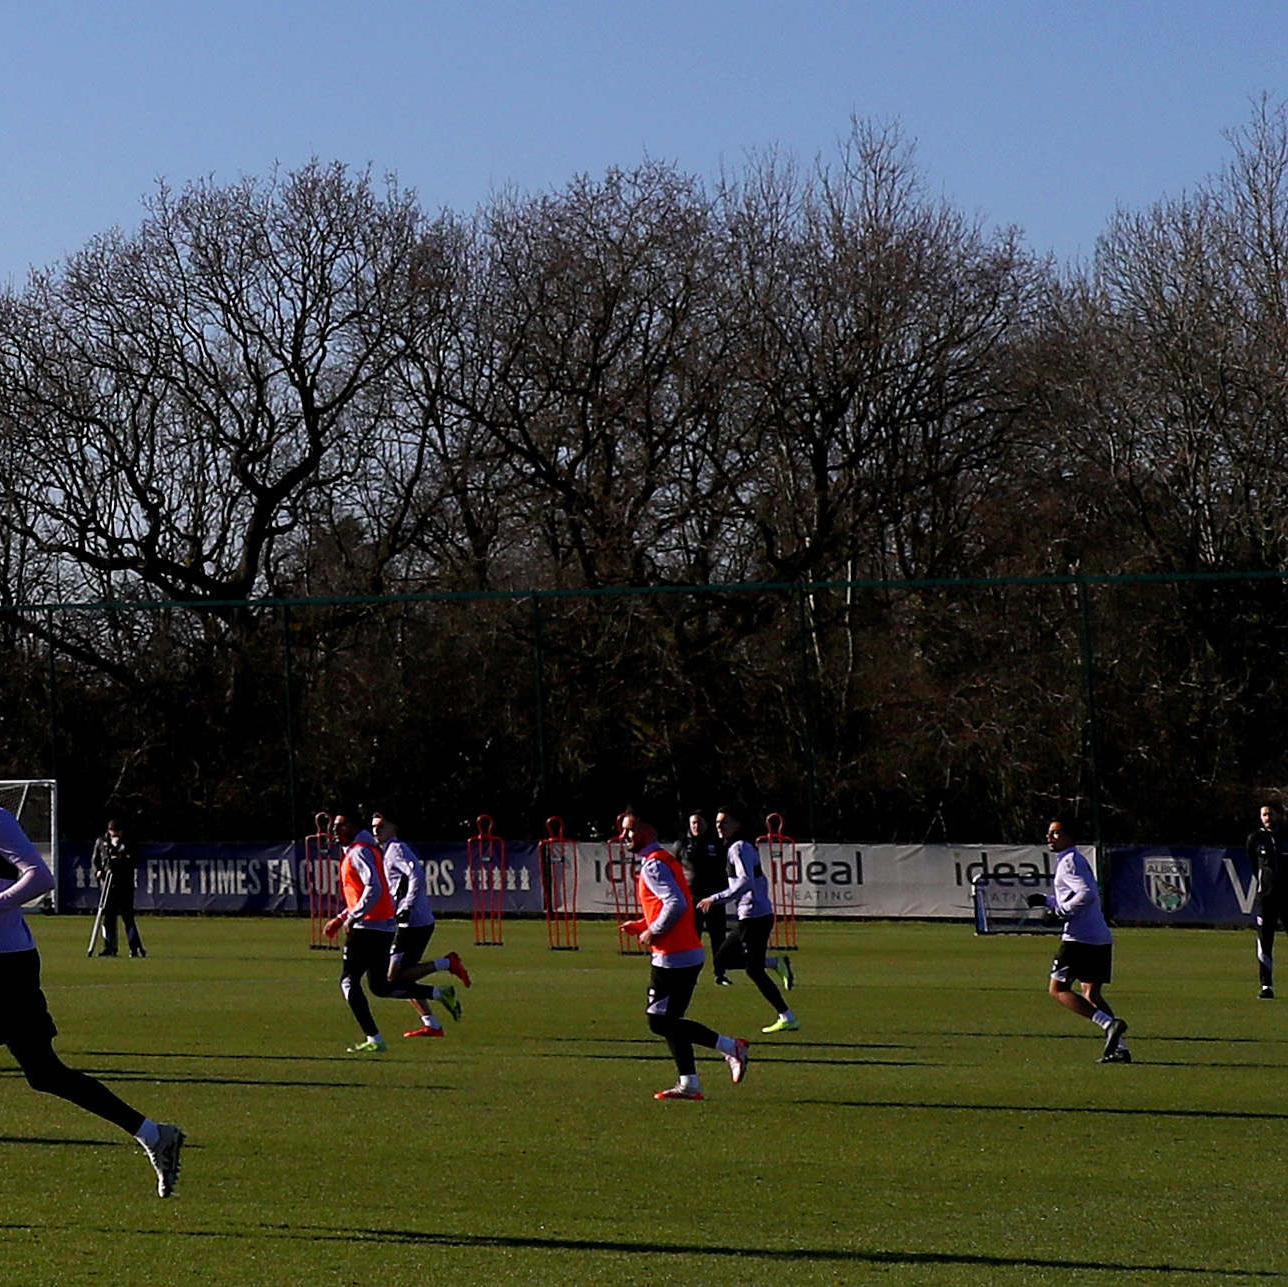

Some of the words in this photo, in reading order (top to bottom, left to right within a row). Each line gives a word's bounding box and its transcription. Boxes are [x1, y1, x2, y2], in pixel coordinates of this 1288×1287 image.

[146, 859, 192, 895] FIVE
[195, 859, 262, 895] TIMES
[267, 859, 295, 895] FA
[771, 850, 863, 885] ideal
[954, 851, 1052, 887] ideal
[784, 890, 854, 901] HEATING
